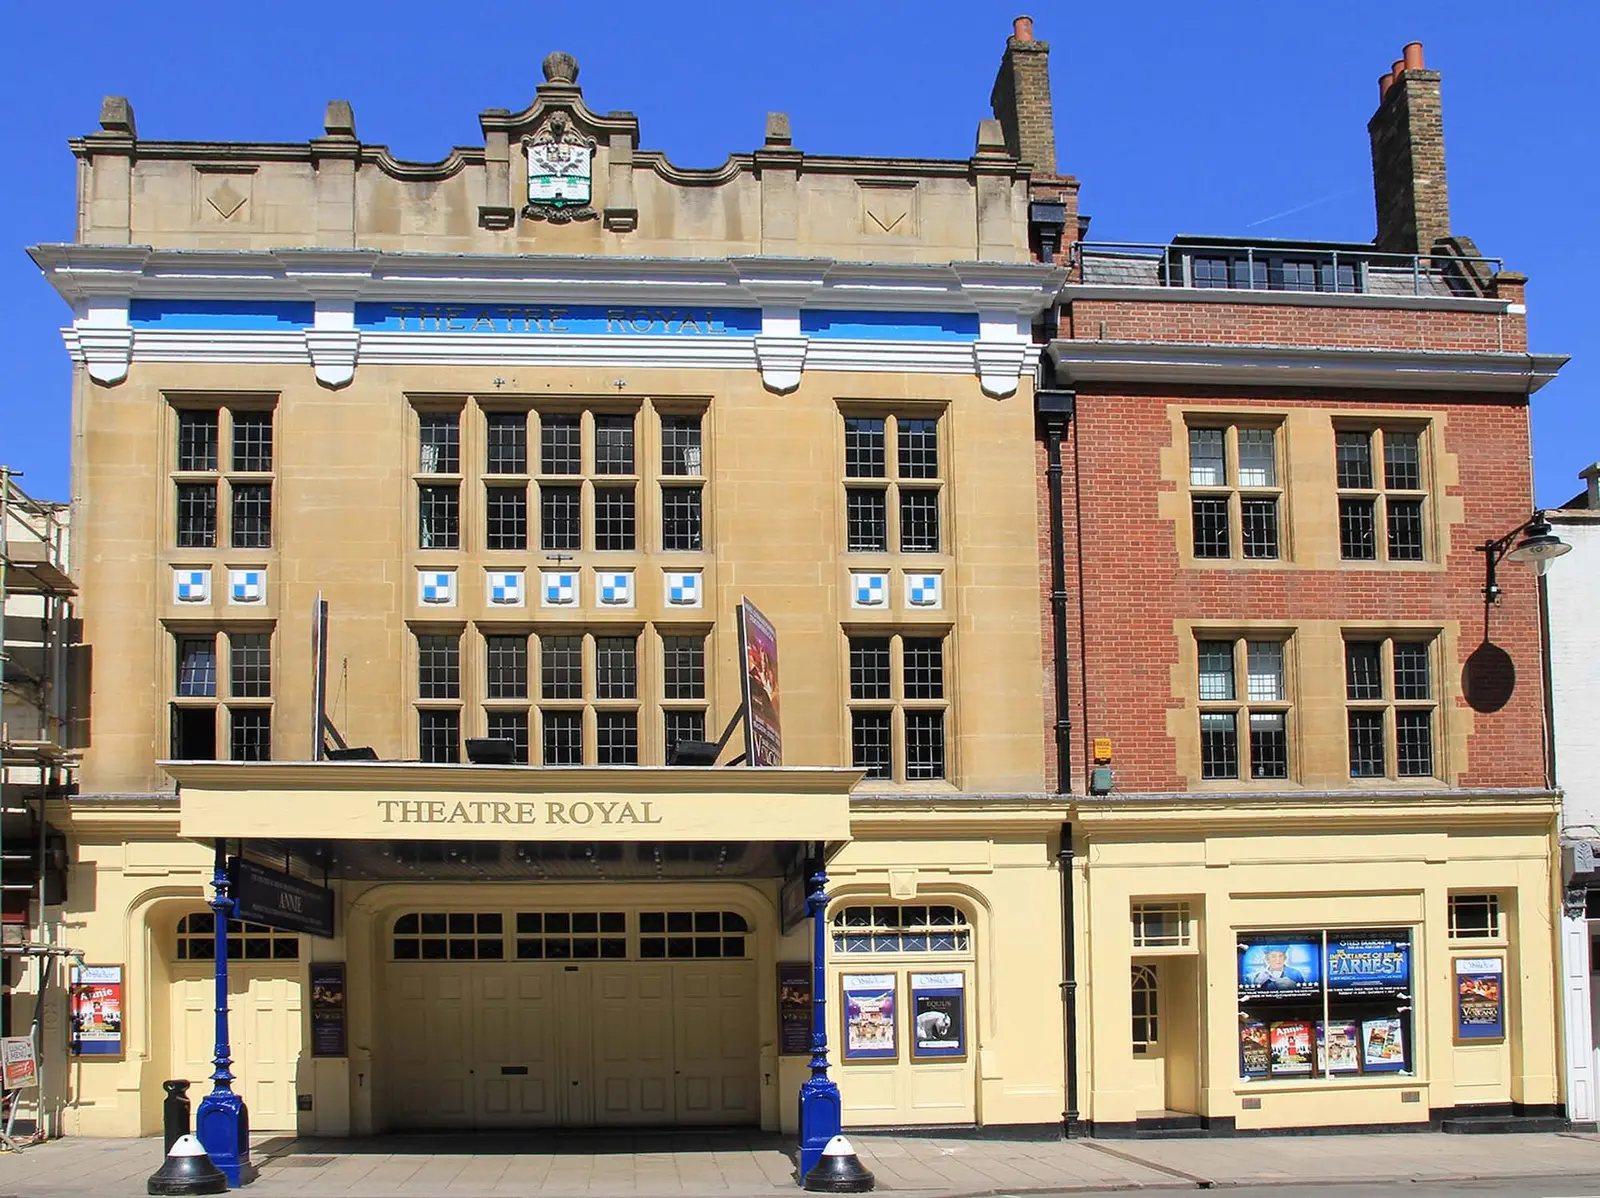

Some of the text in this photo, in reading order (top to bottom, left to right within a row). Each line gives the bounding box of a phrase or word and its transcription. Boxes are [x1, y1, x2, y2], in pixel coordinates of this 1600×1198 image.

[391, 306, 727, 334] THEATRE ROYAL
[377, 800, 663, 825] THEATRE ROYAL
[1329, 958, 1404, 975] EARNEST
[81, 988, 113, 1001] Annie
[1276, 1024, 1304, 1036] Annie
